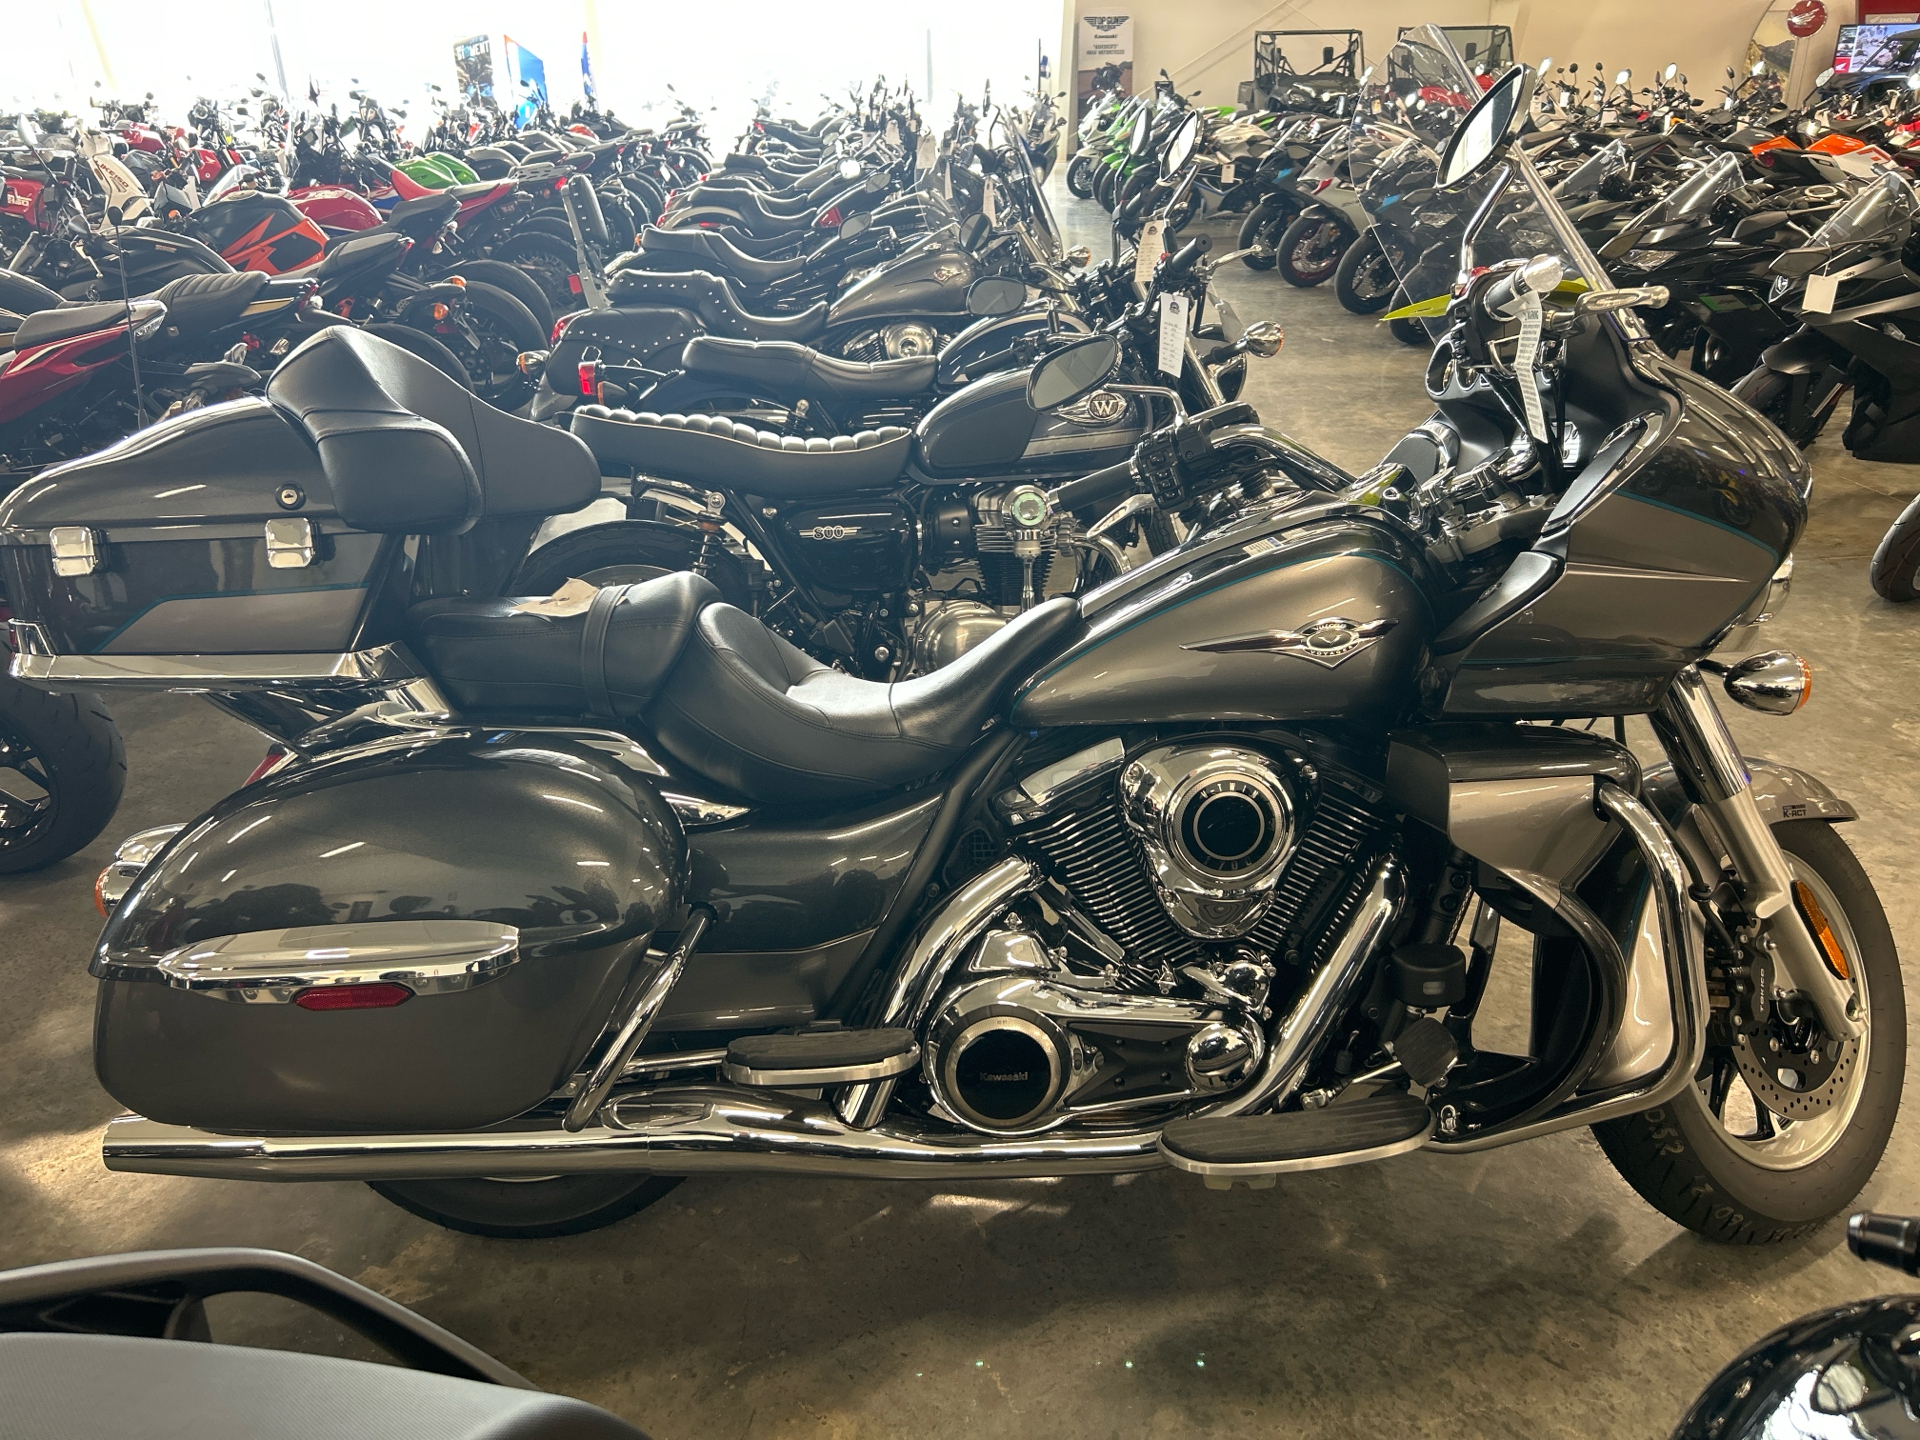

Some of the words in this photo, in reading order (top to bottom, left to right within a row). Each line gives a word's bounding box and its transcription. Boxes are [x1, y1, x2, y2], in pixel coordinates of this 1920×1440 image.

[813, 525, 845, 540] 800
[1310, 645, 1353, 656] VOYAGER
[1200, 782, 1259, 799] V-TWIN
[1783, 809, 1807, 818] K-ACT
[980, 1071, 1028, 1081] Kawasaki
